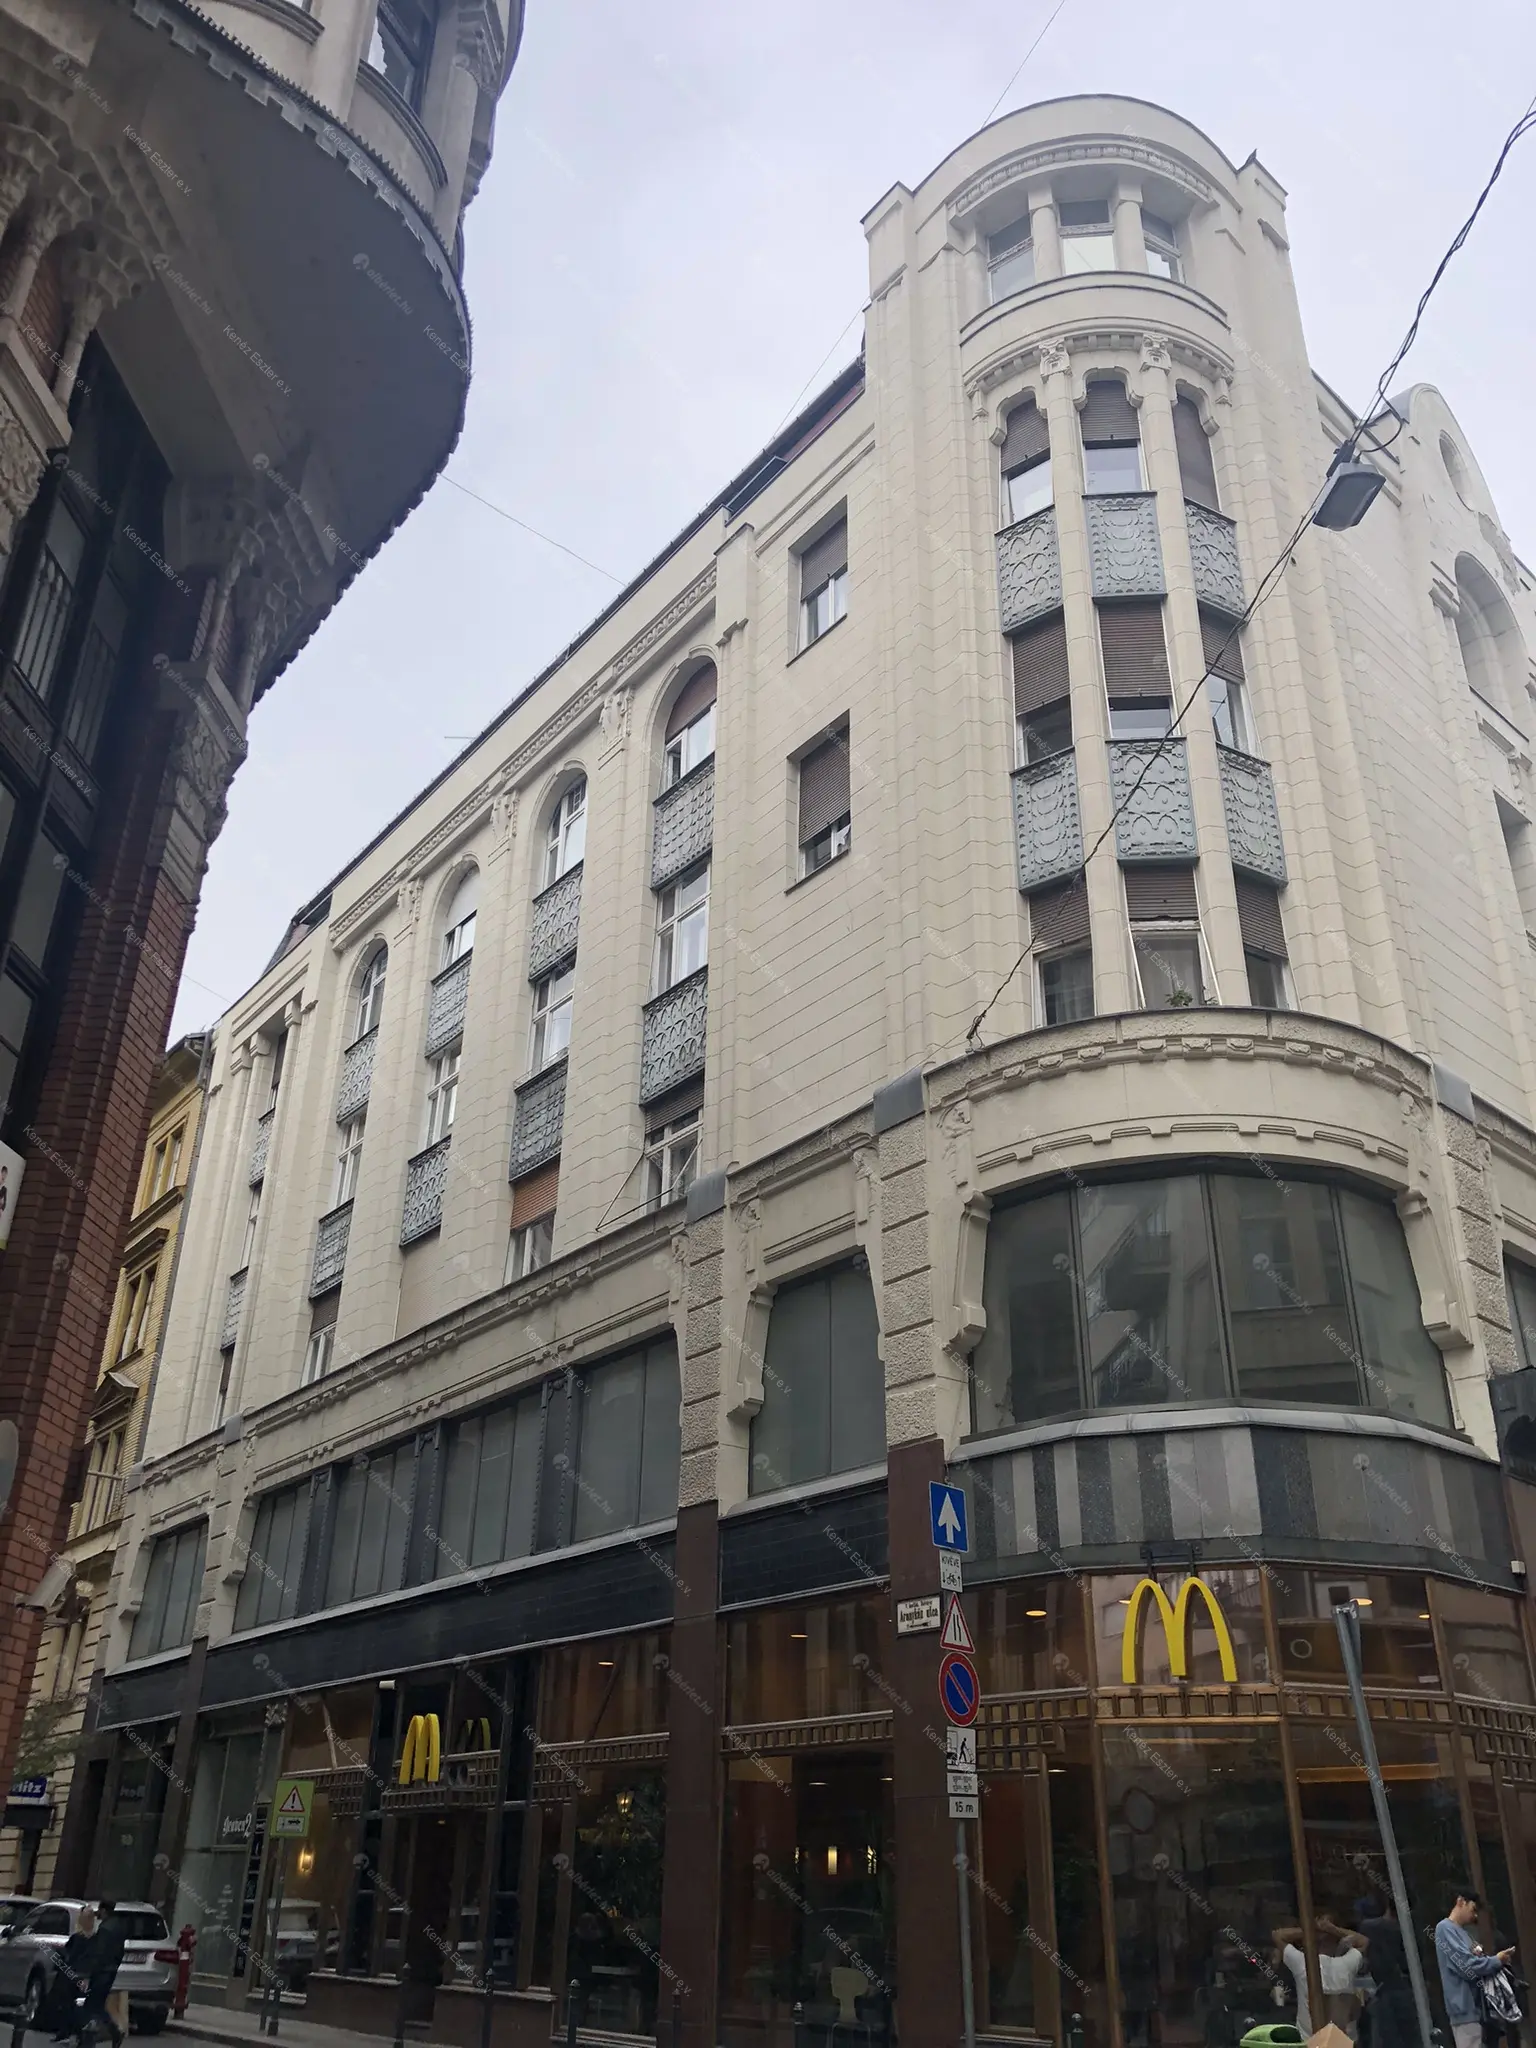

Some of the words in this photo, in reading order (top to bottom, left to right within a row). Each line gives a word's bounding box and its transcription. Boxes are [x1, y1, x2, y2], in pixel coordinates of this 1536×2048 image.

[926, 1606, 938, 1618] utca
[955, 1801, 963, 1812] 15
[965, 1804, 974, 1813] m
